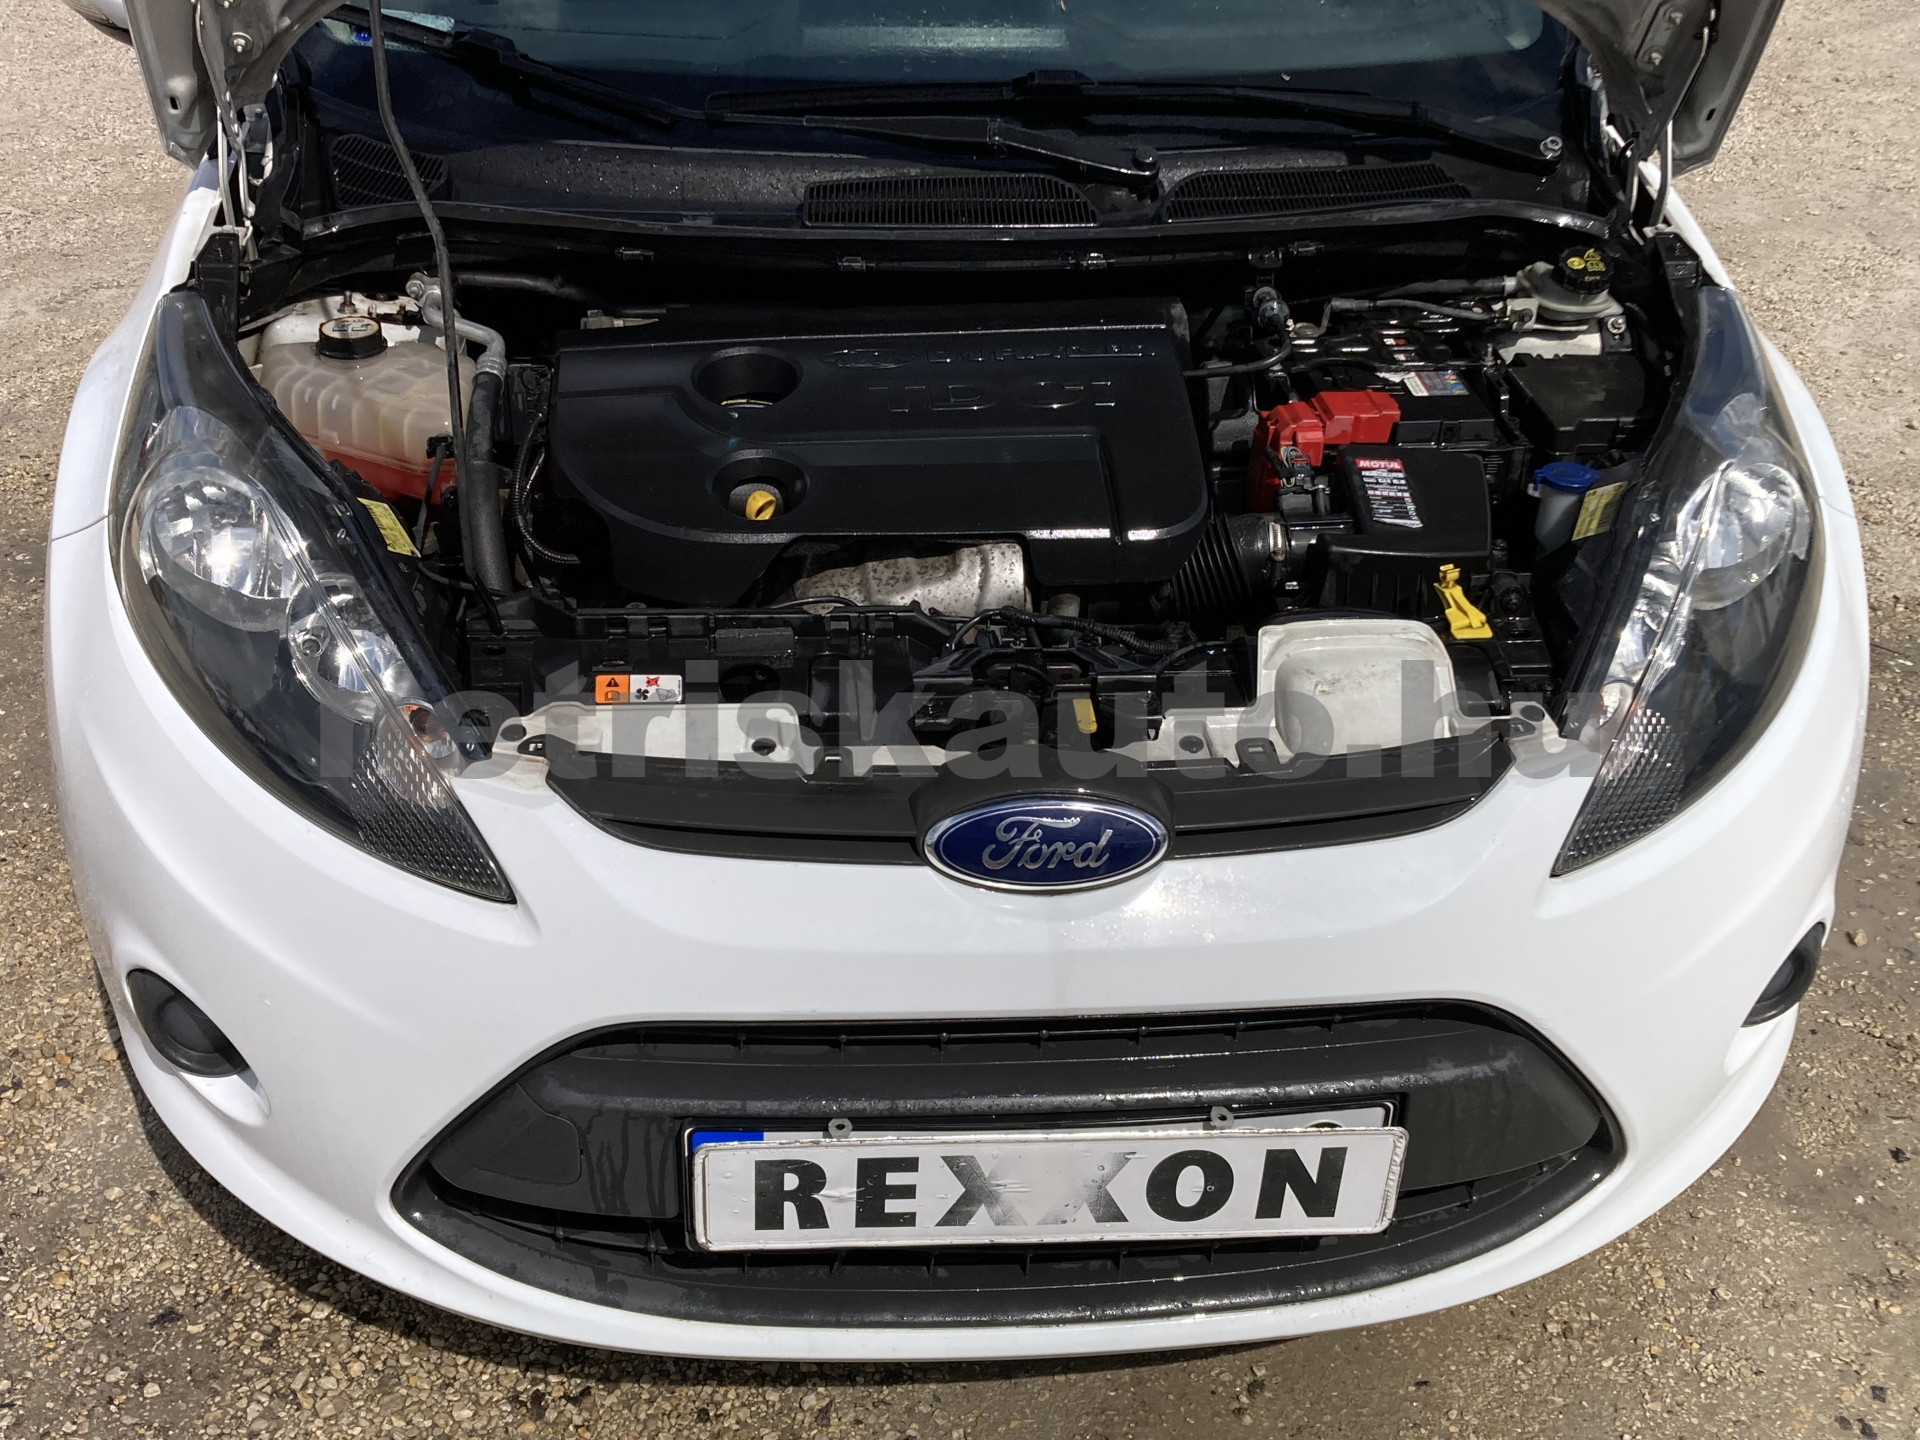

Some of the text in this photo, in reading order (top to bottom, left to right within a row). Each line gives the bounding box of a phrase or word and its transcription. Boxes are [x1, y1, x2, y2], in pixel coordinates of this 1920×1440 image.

[1358, 459, 1401, 469] MOTUL
[982, 816, 1114, 870] Ford
[754, 1146, 1349, 1230] REXXON
